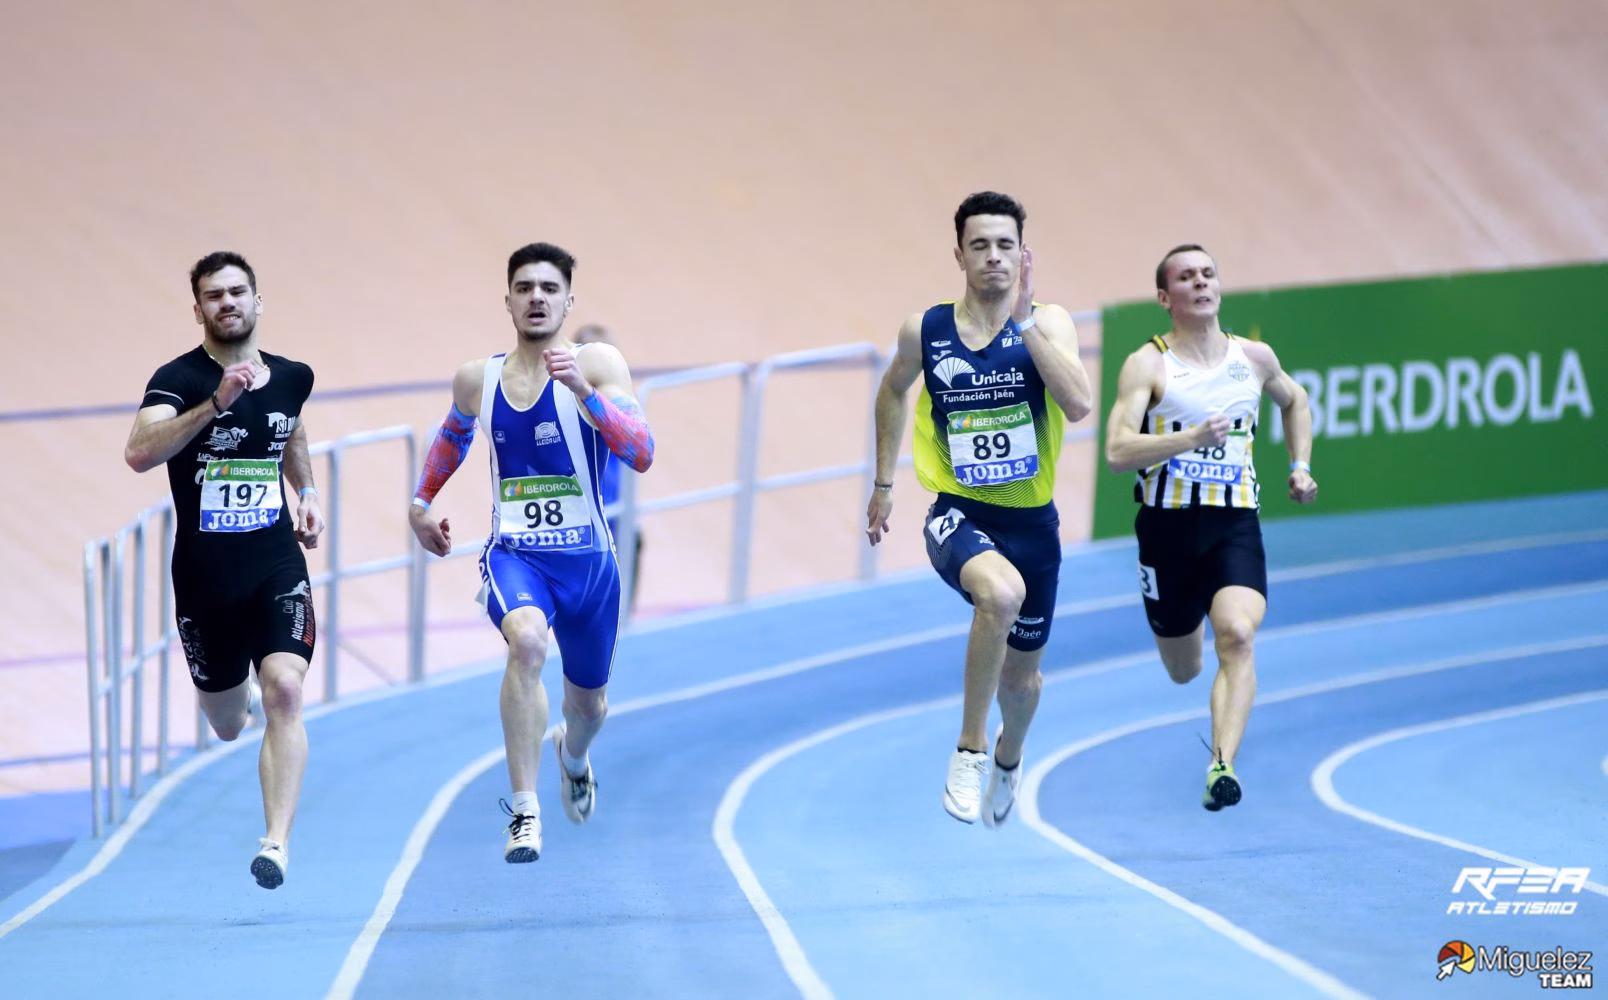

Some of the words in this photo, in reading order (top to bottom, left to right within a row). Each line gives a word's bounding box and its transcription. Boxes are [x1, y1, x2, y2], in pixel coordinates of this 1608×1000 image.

[971, 367, 1025, 386] Unicaja
[943, 391, 991, 403] Fundación
[994, 389, 1015, 400] Jaén
[973, 412, 1026, 427] IBERDROLA
[972, 432, 1012, 461] 89
[230, 467, 274, 477] IBERDROLA
[218, 483, 268, 509] 197
[523, 482, 579, 495] IBERDROLA
[524, 500, 564, 529] 98
[1140, 566, 1152, 594] 3
